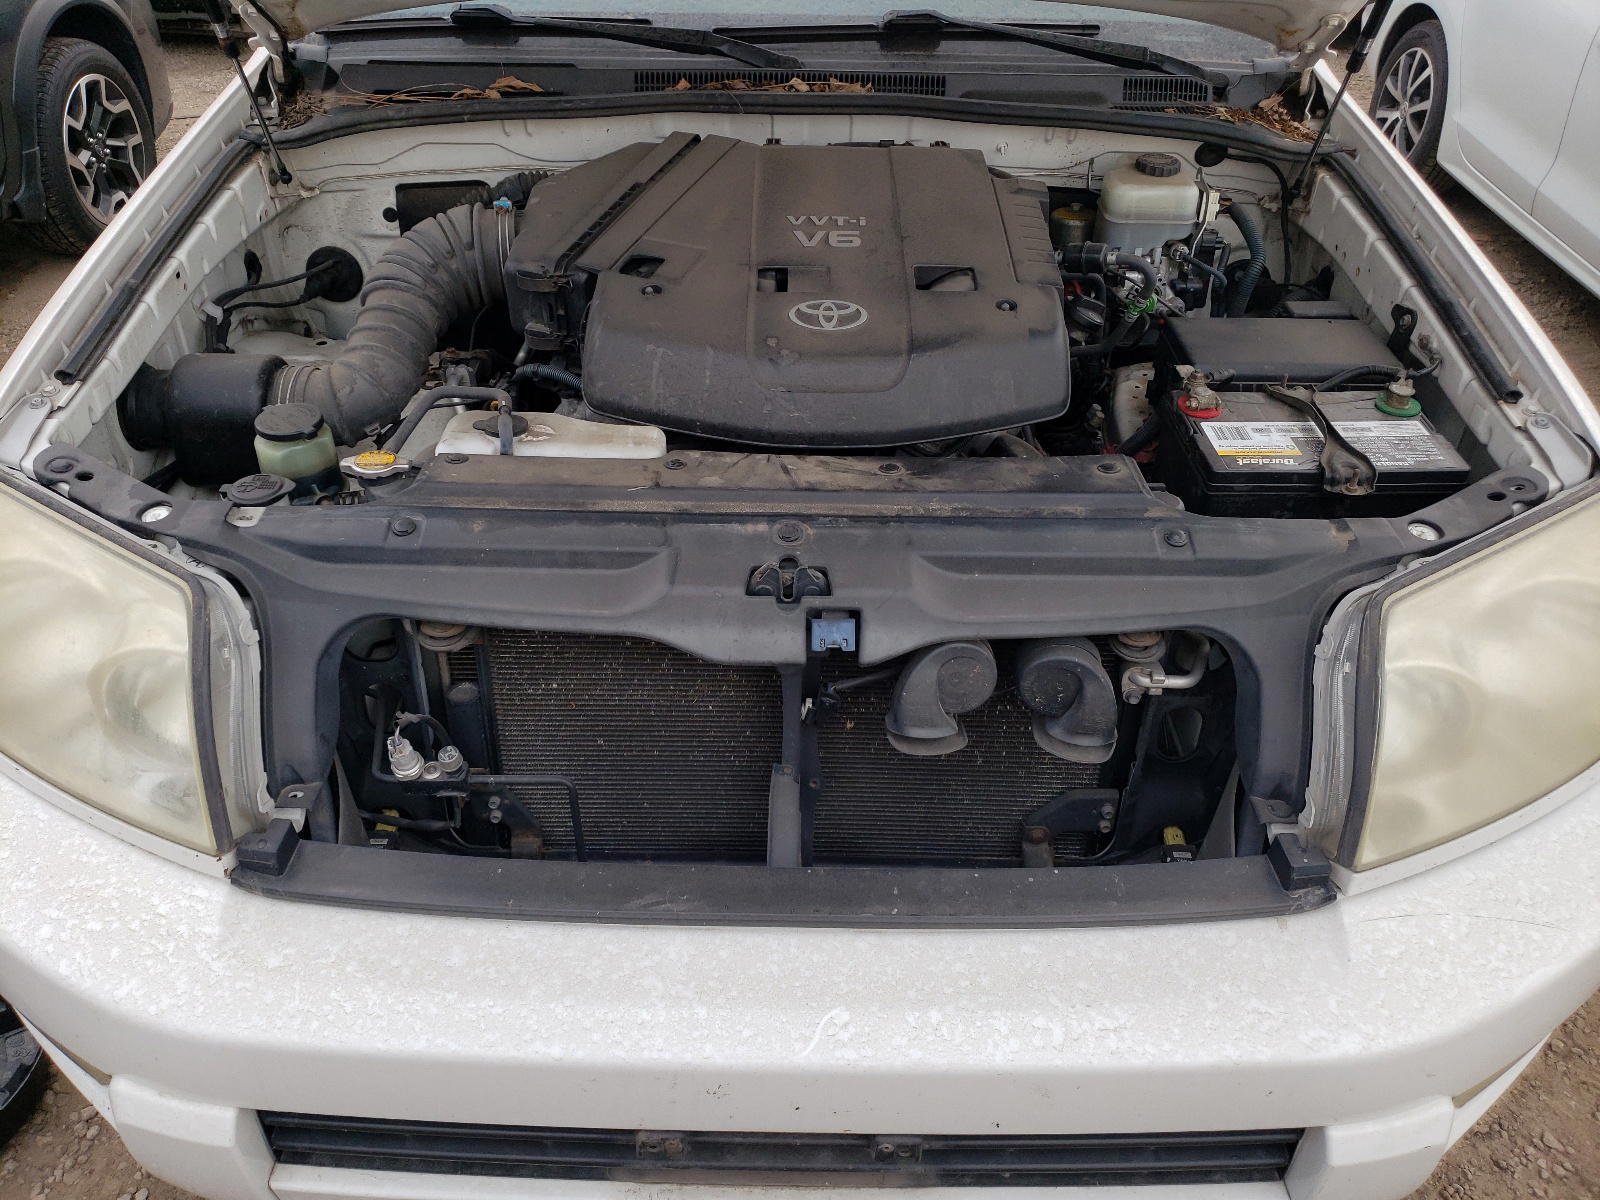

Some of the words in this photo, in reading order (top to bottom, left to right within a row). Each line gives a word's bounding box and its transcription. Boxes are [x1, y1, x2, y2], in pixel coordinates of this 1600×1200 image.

[786, 215, 867, 226] VVT-i
[793, 230, 862, 248] V6
[1236, 458, 1299, 466] Duralast
